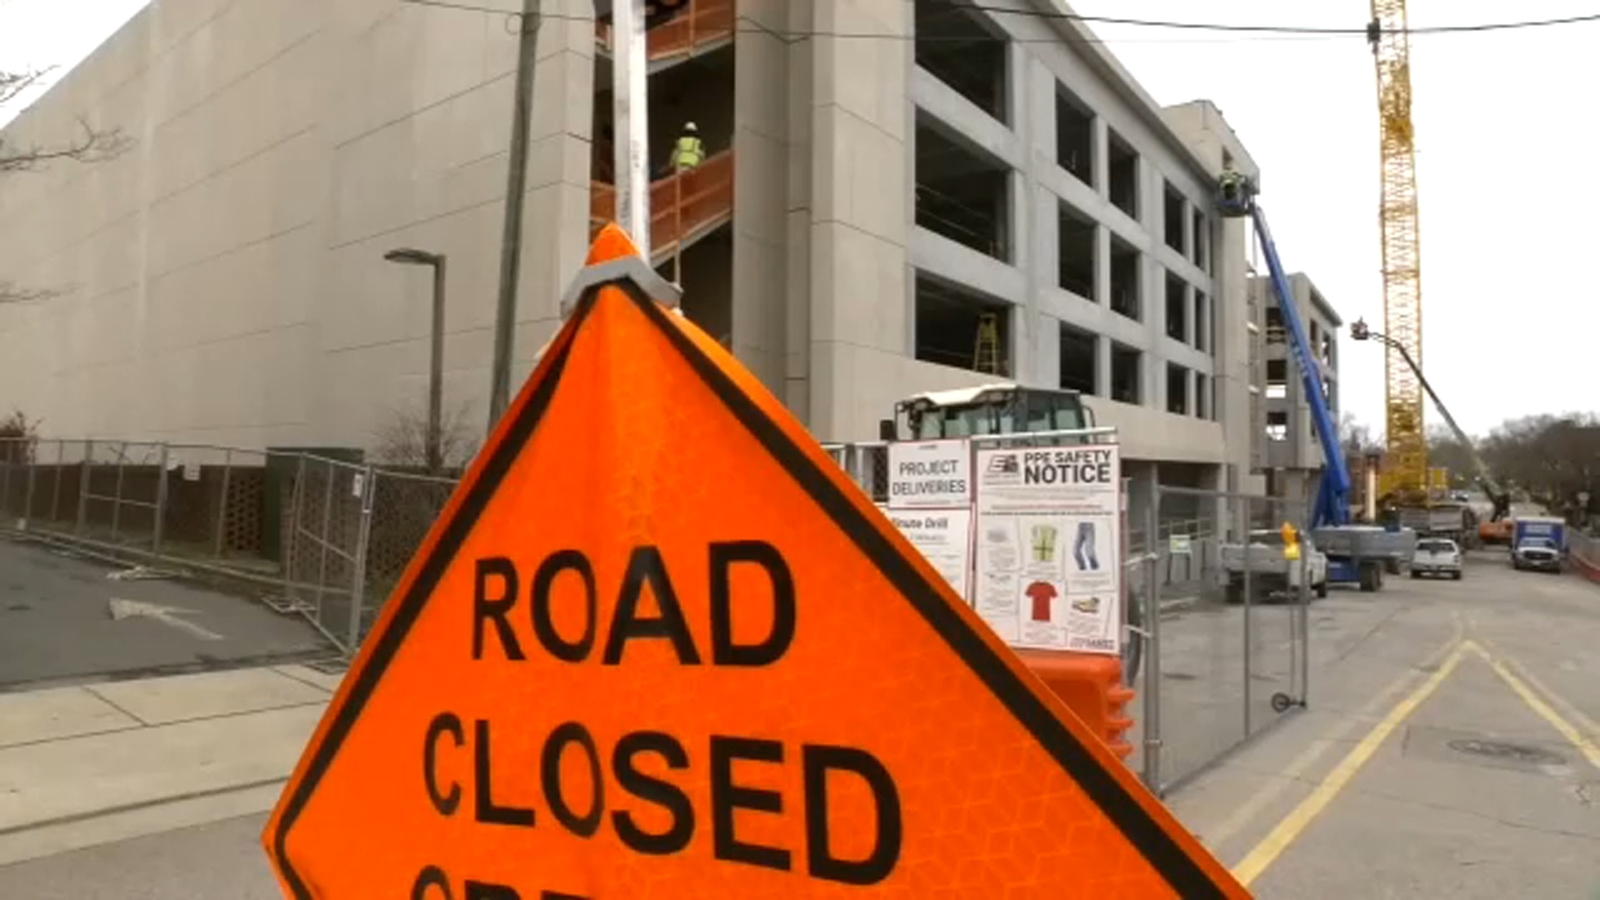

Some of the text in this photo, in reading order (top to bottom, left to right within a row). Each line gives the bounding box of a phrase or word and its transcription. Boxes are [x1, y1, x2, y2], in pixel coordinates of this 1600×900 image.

[1054, 449, 1111, 463] SAFETY
[899, 460, 959, 476] PROJECT
[1024, 462, 1111, 484] NOTICE
[892, 479, 966, 496] DELIVERIES
[924, 517, 948, 529] Drill
[472, 540, 797, 667] ROAD
[423, 711, 904, 885] CLOSED
